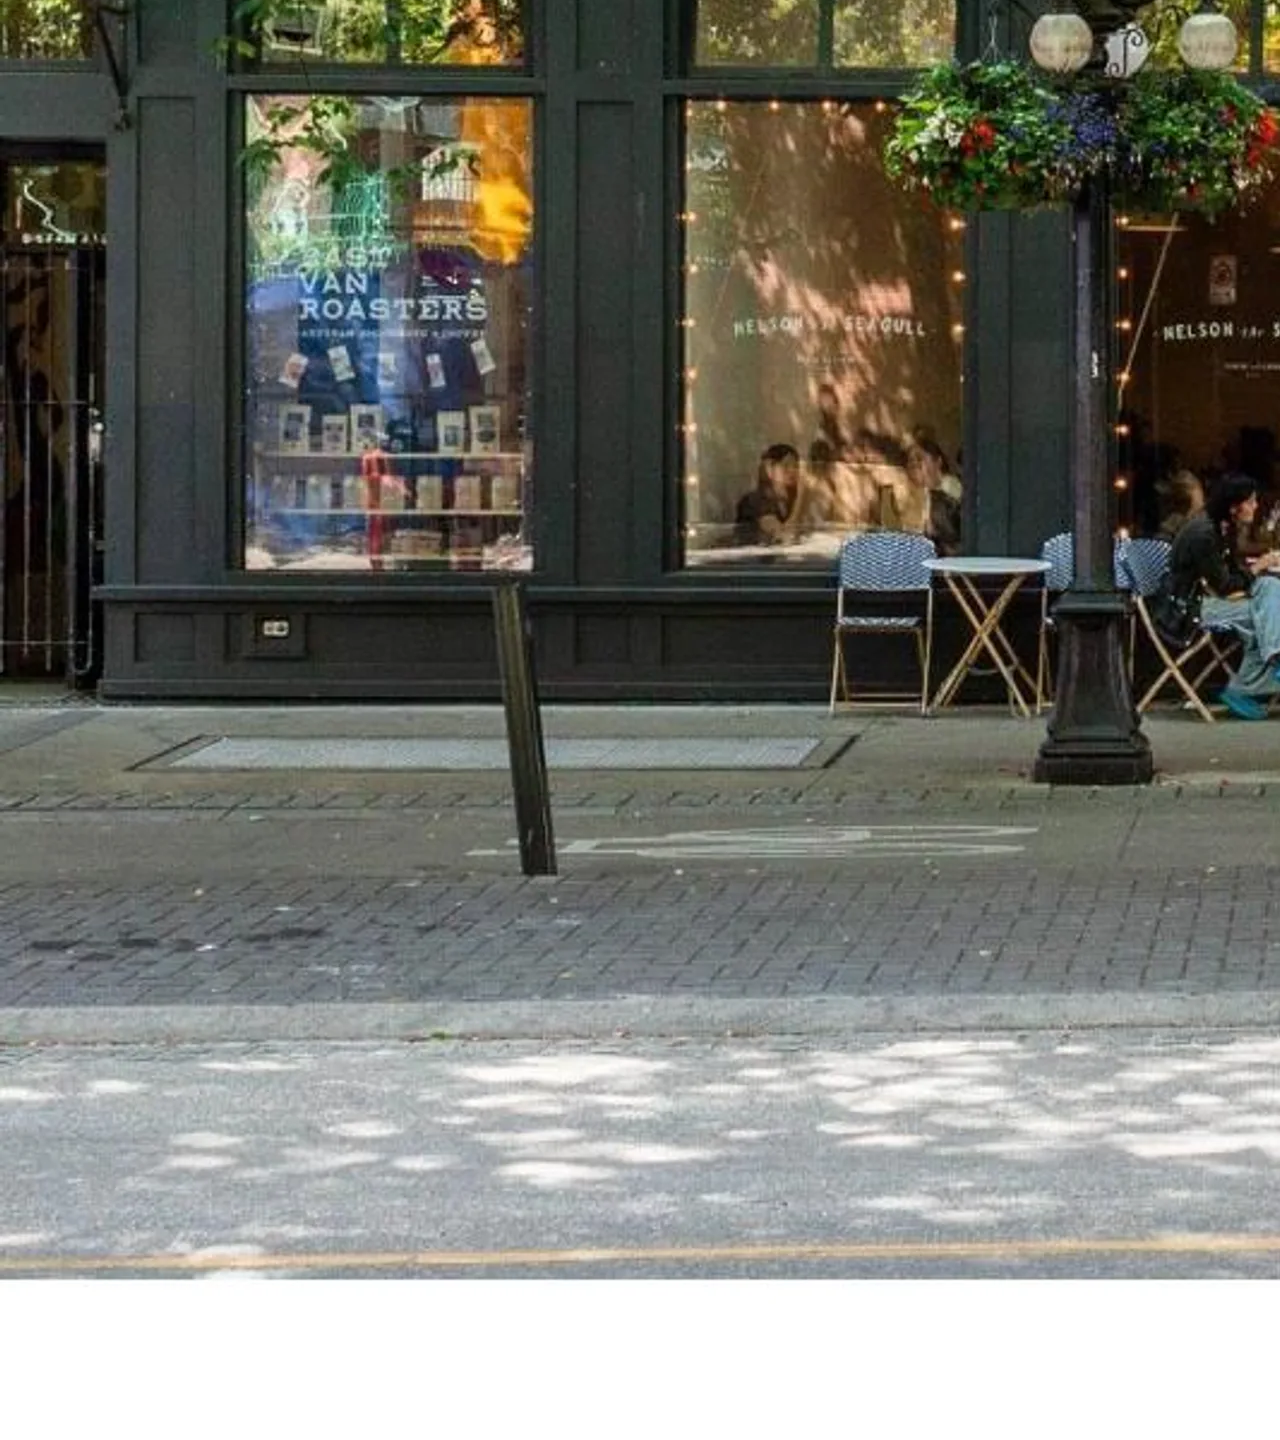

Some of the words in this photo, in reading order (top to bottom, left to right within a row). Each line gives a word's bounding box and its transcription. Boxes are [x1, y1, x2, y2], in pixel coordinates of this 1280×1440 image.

[299, 271, 368, 294] VAN
[300, 297, 488, 321] ROASTERS
[734, 316, 802, 337] NELSON
[844, 316, 926, 337] SEAGULL
[1163, 322, 1234, 341] NELSON
